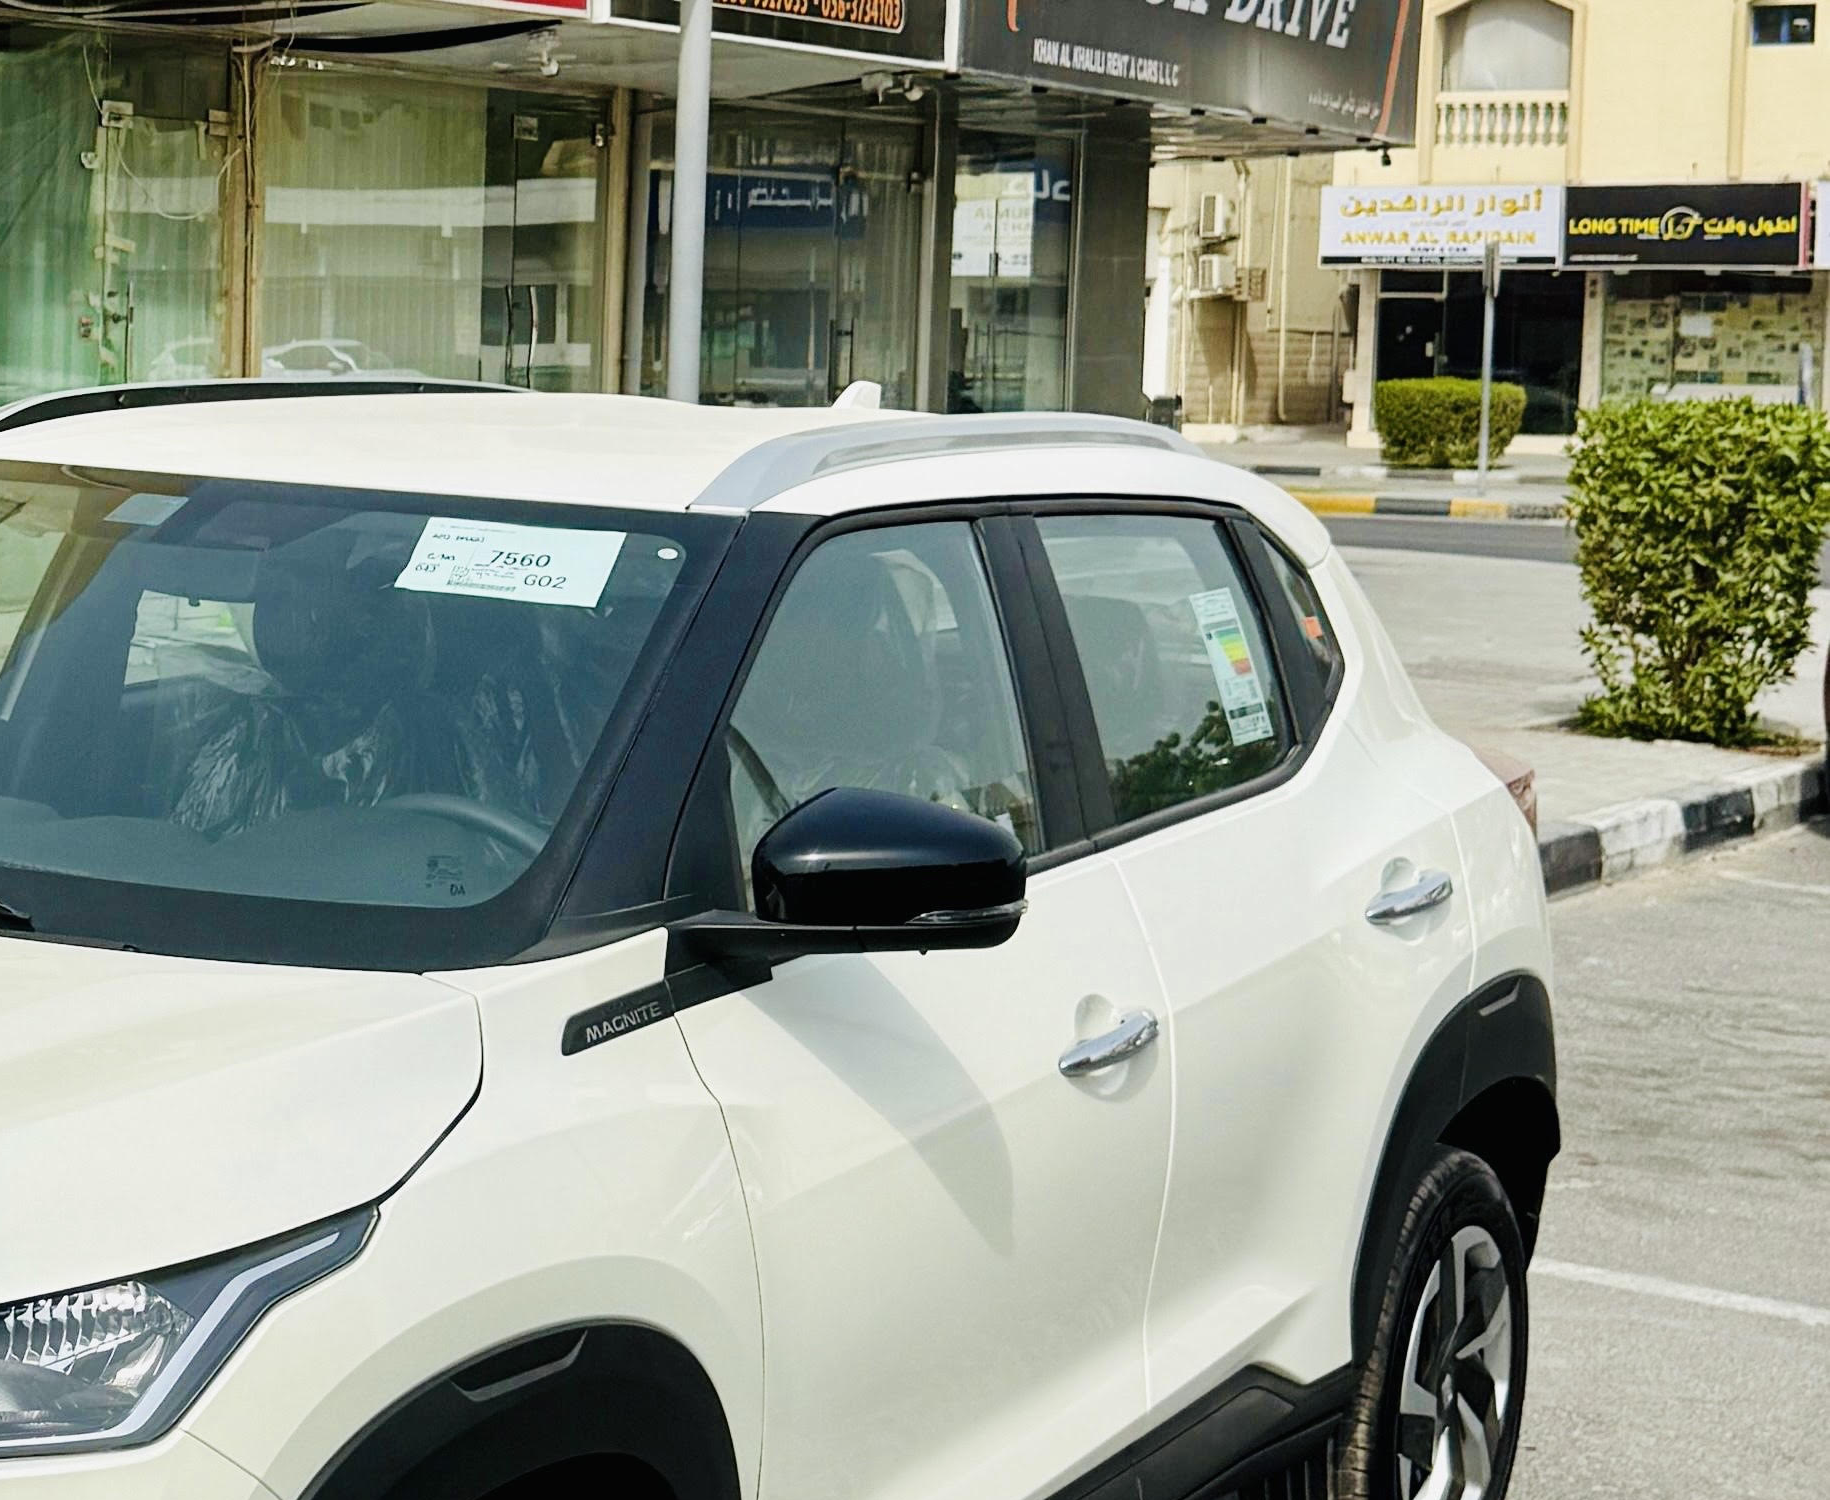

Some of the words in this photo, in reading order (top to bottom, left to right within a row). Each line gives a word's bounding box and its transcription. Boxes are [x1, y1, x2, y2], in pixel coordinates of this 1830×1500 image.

[1033, 38, 1059, 65] KHAN
[1059, 43, 1071, 68] AL
[1106, 52, 1130, 79] RENT
[1569, 217, 1617, 235] LONG
[1618, 217, 1660, 235] TIME
[1341, 230, 1410, 245] ANWAR
[1416, 230, 1440, 245] AL
[490, 550, 551, 568] 7560
[586, 1001, 662, 1043] MAGNITE
